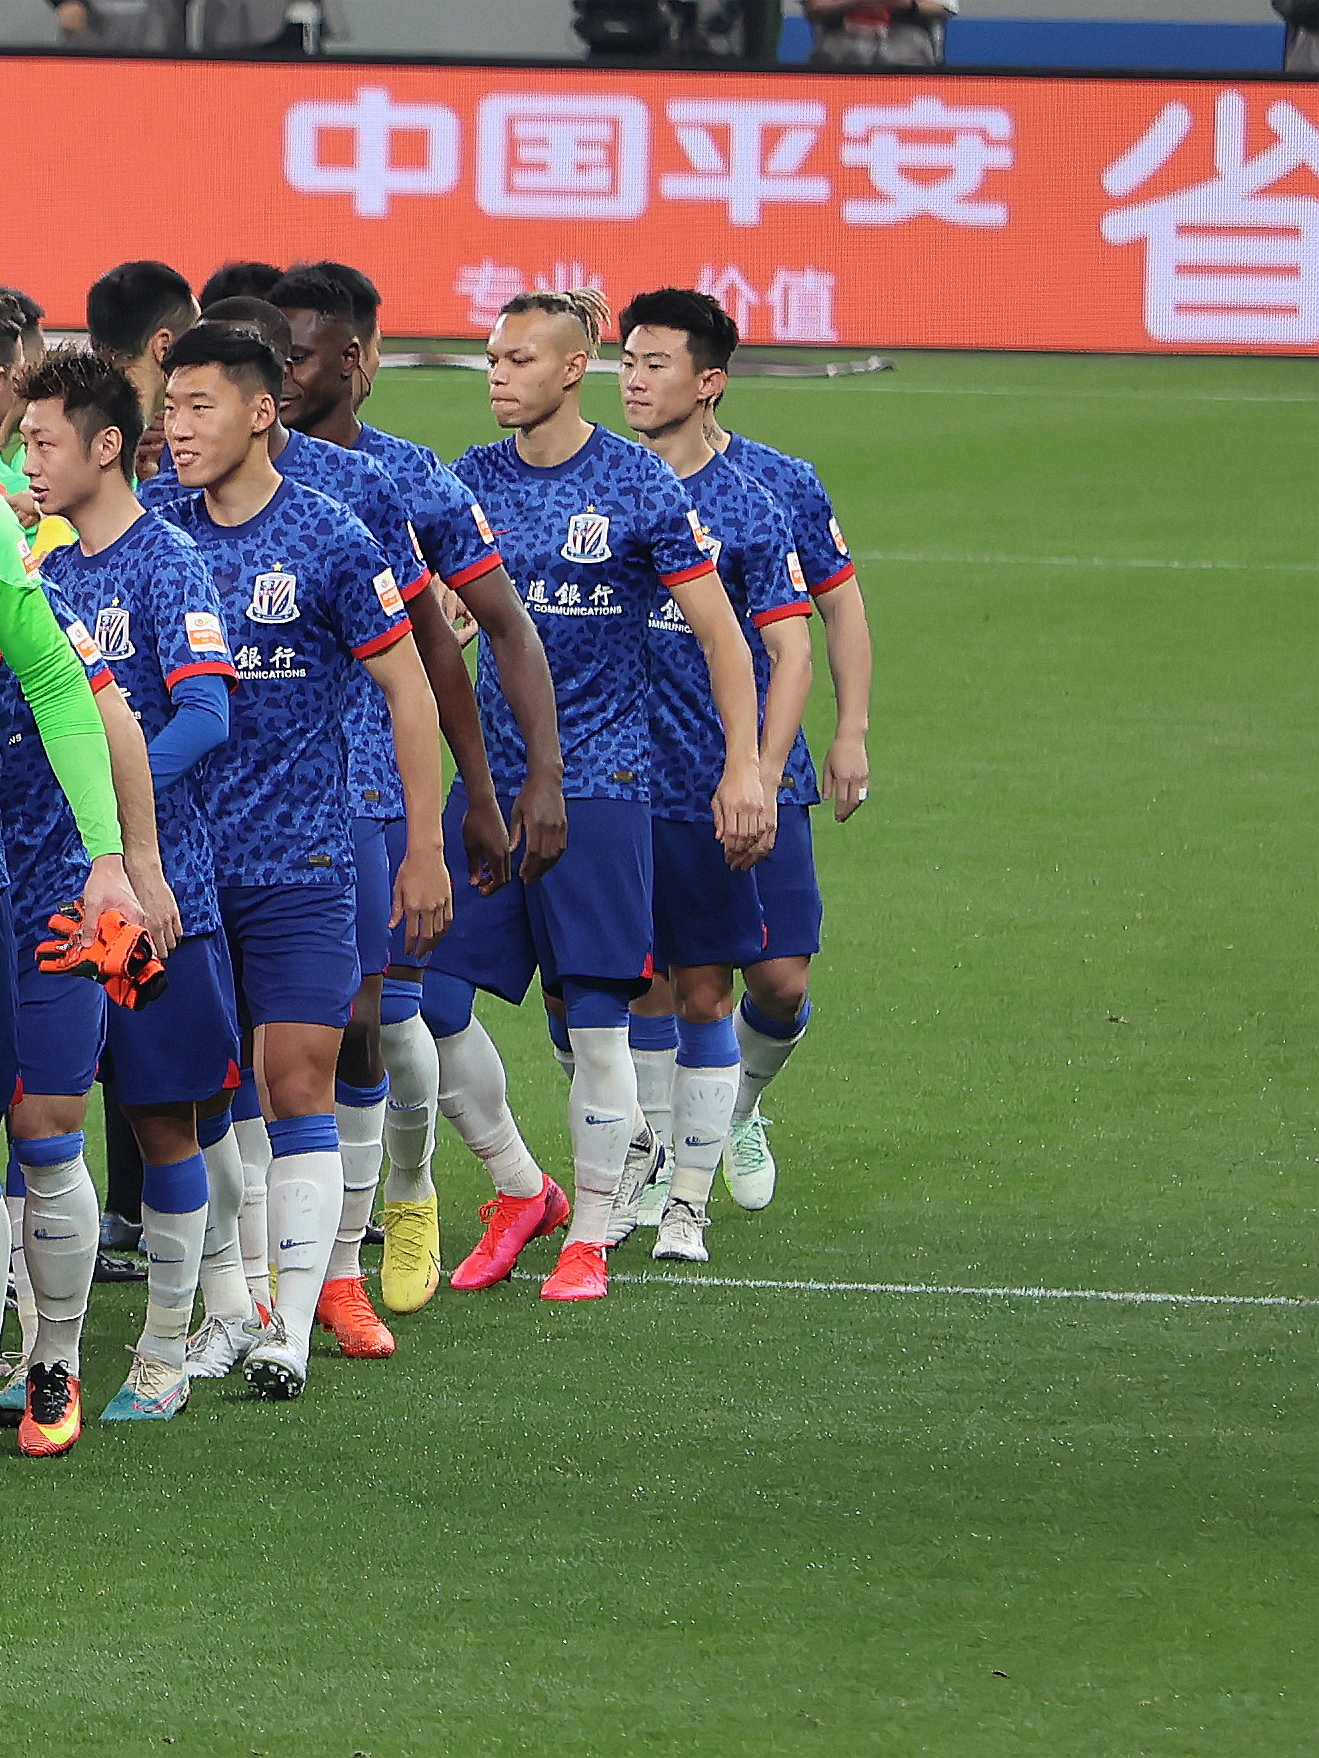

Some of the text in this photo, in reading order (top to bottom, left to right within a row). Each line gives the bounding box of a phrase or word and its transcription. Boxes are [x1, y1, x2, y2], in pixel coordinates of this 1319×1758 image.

[283, 86, 1015, 229] 中国平安
[1100, 88, 1319, 345] 省
[511, 579, 614, 606] 通銀行
[533, 603, 623, 616] COMMUNICATIONS
[234, 645, 296, 670] 銀行
[235, 668, 307, 680] MUNICATIONS
